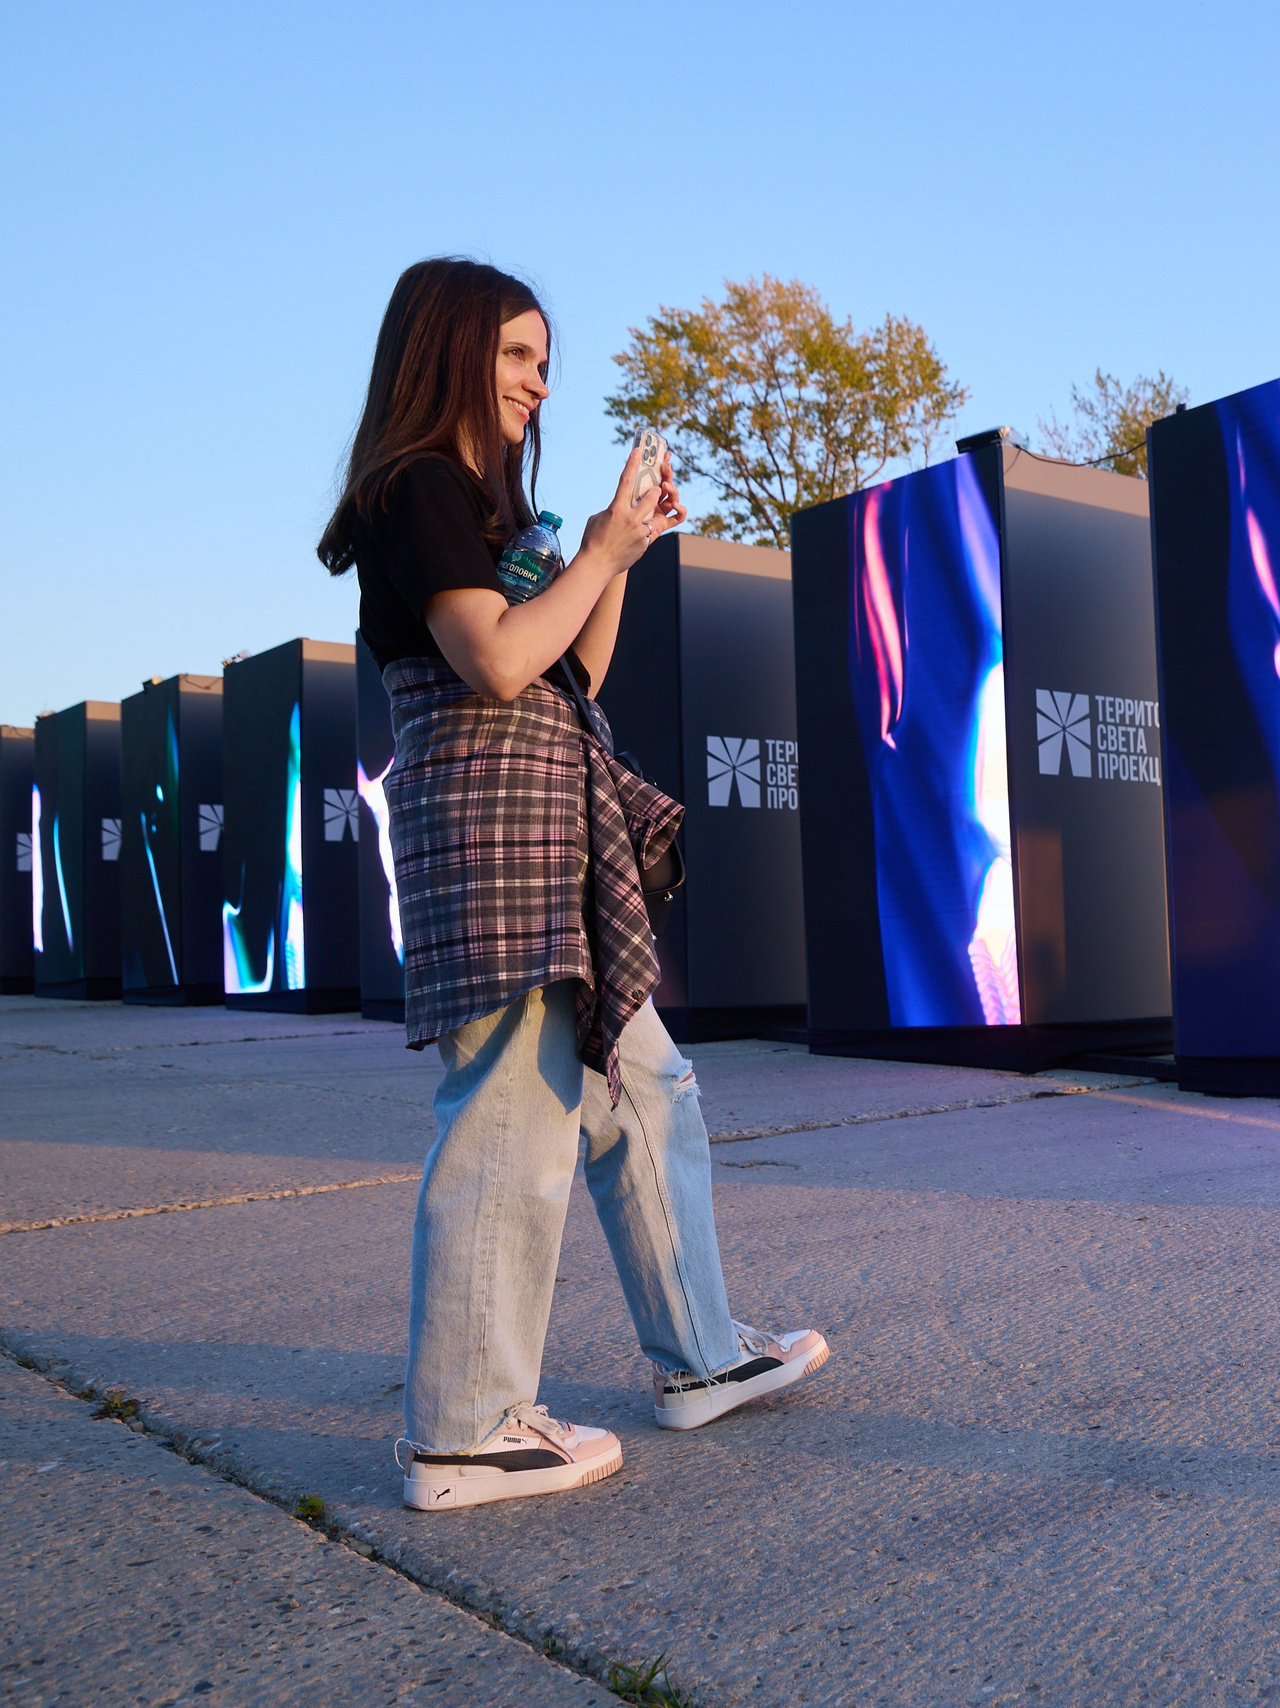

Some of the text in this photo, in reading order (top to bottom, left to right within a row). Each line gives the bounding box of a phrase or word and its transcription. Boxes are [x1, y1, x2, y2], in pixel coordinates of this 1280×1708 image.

[1096, 723, 1148, 754] СВЕТА
[766, 763, 799, 786] СВЕ
[1098, 752, 1161, 786] ПРОЕКЦ
[767, 786, 799, 810] ПРО
